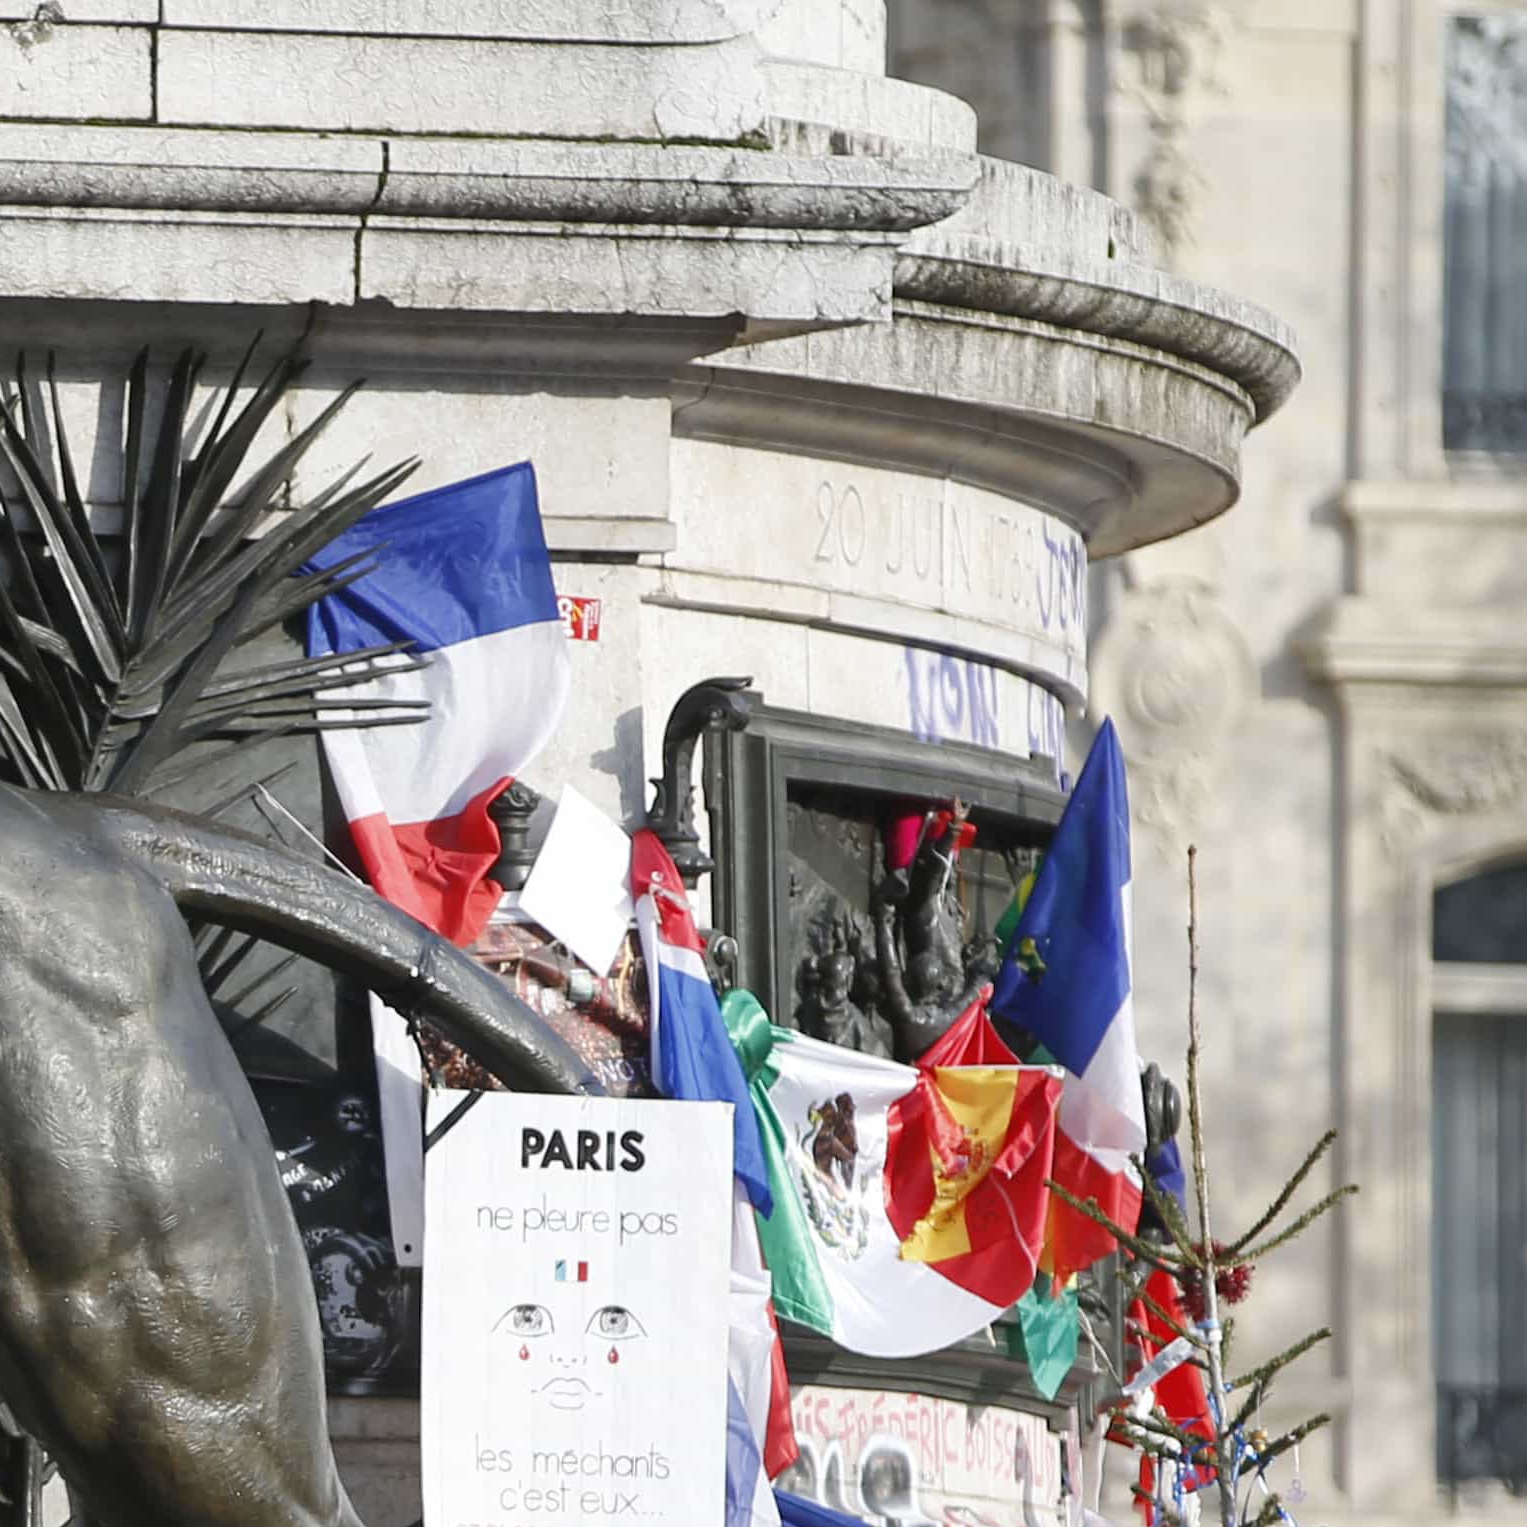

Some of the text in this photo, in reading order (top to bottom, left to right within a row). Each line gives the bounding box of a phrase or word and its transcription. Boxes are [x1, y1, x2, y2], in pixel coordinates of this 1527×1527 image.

[814, 478, 867, 568] 20
[886, 490, 973, 592] JUIN
[520, 1126, 646, 1173] PARIS
[477, 1193, 679, 1246] ne pleure pas
[474, 1433, 672, 1480] les méchants
[500, 1482, 566, 1515] c'est
